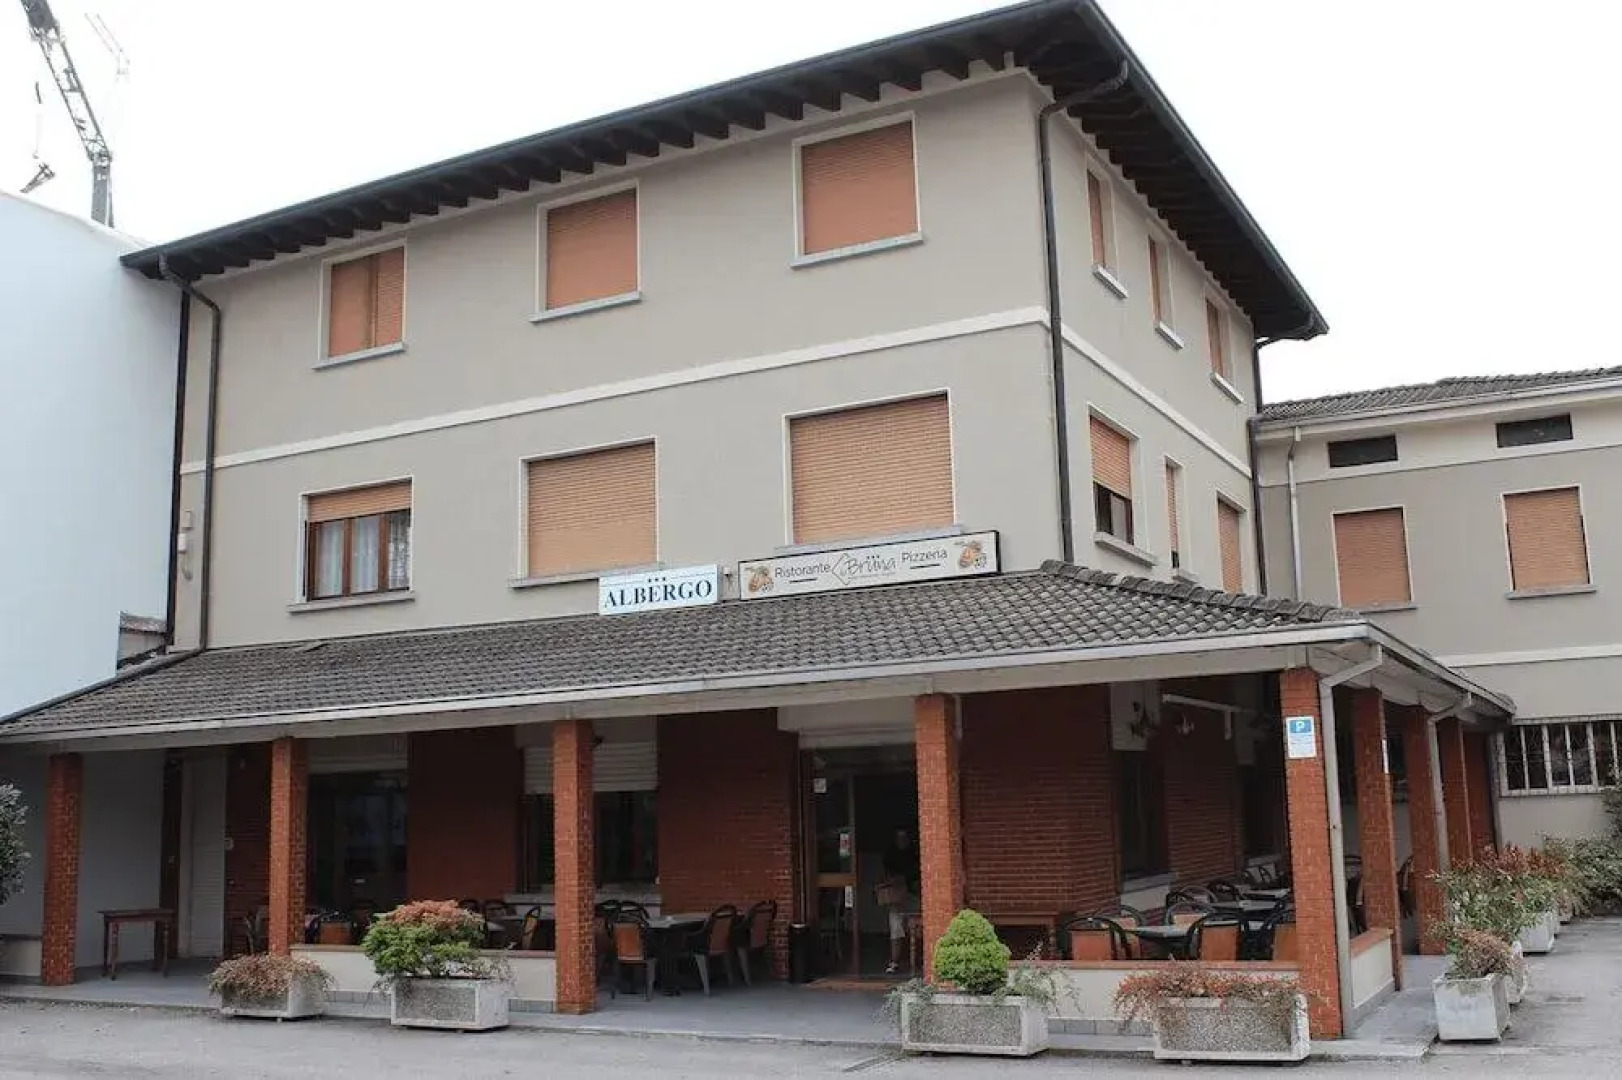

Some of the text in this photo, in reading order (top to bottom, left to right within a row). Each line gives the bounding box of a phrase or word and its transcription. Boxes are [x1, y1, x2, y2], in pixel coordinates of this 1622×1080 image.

[774, 563, 831, 578] Ristorante
[901, 549, 948, 563] Pizzeria
[604, 580, 712, 608] ALBERGO
